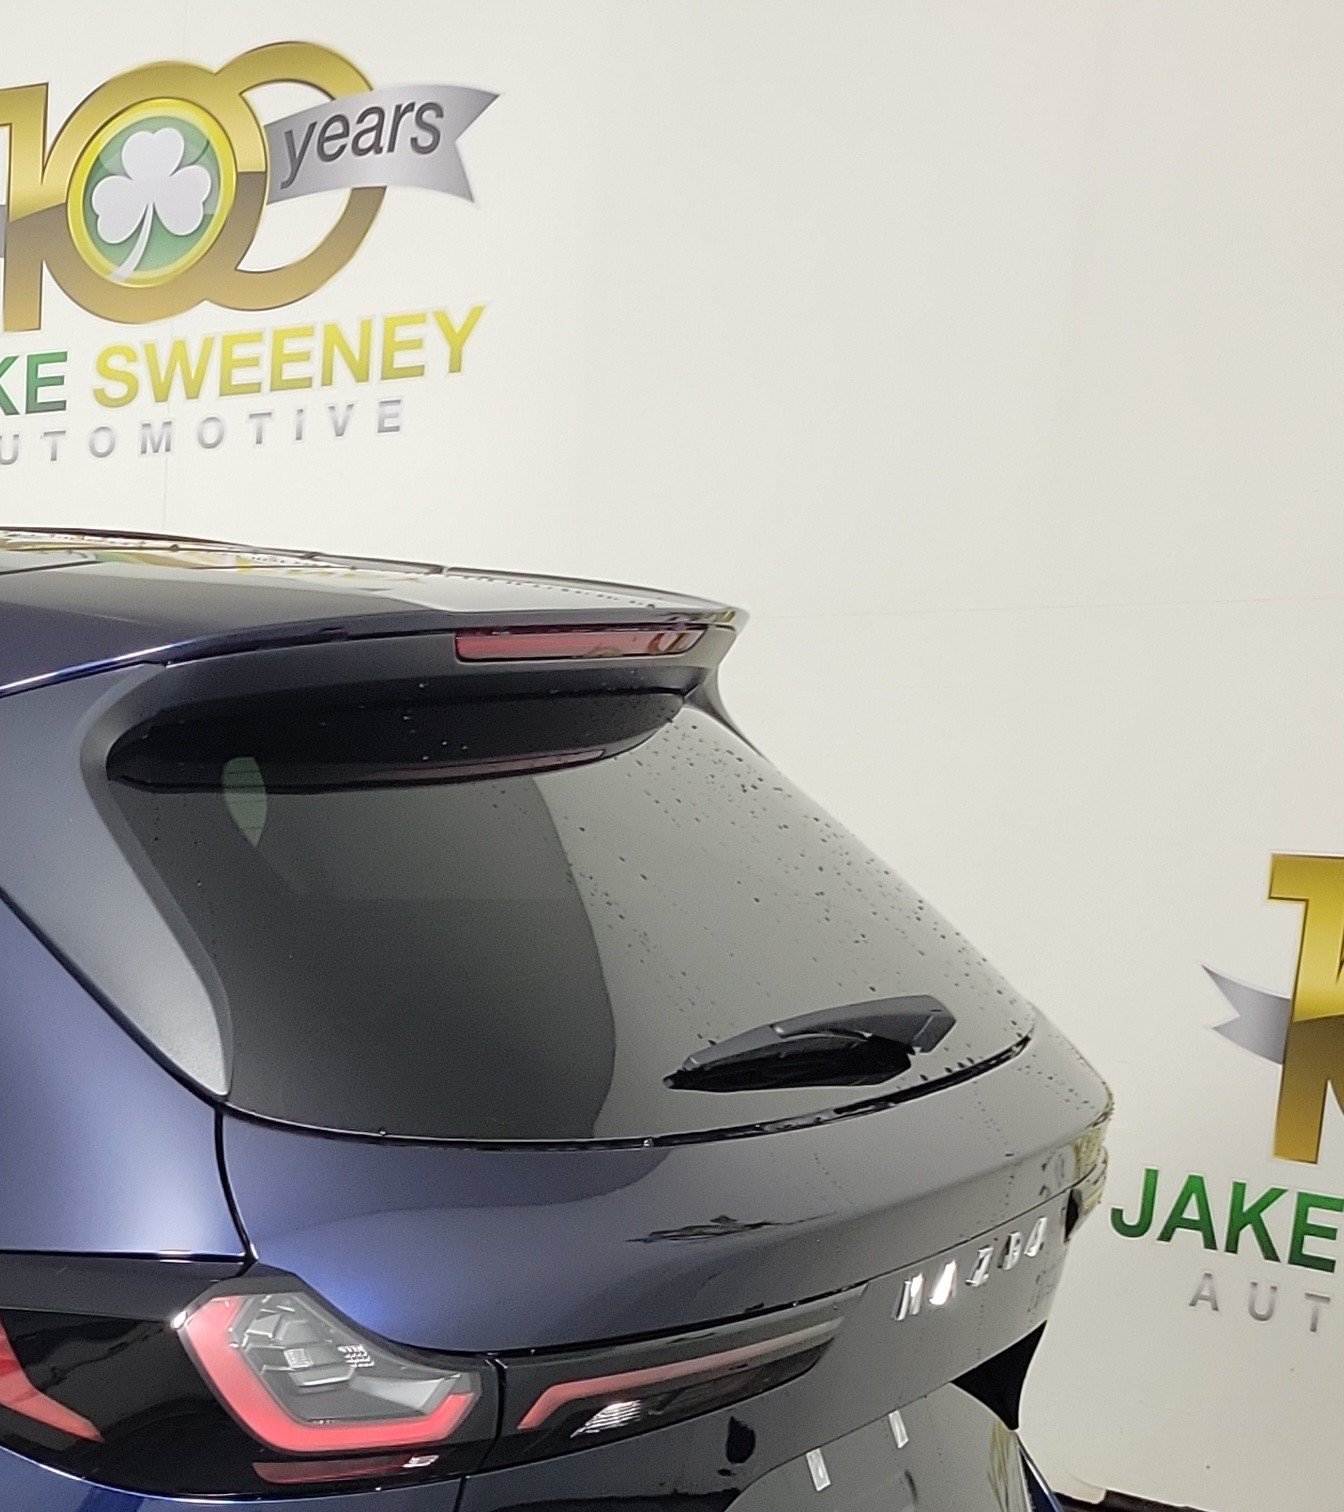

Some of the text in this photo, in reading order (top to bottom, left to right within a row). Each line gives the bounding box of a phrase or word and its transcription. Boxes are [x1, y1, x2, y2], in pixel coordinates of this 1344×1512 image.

[279, 98, 446, 191] years
[92, 306, 487, 409] SWEENEY
[891, 1216, 1048, 1321] MAZDA
[1110, 1168, 1344, 1273] JAKE
